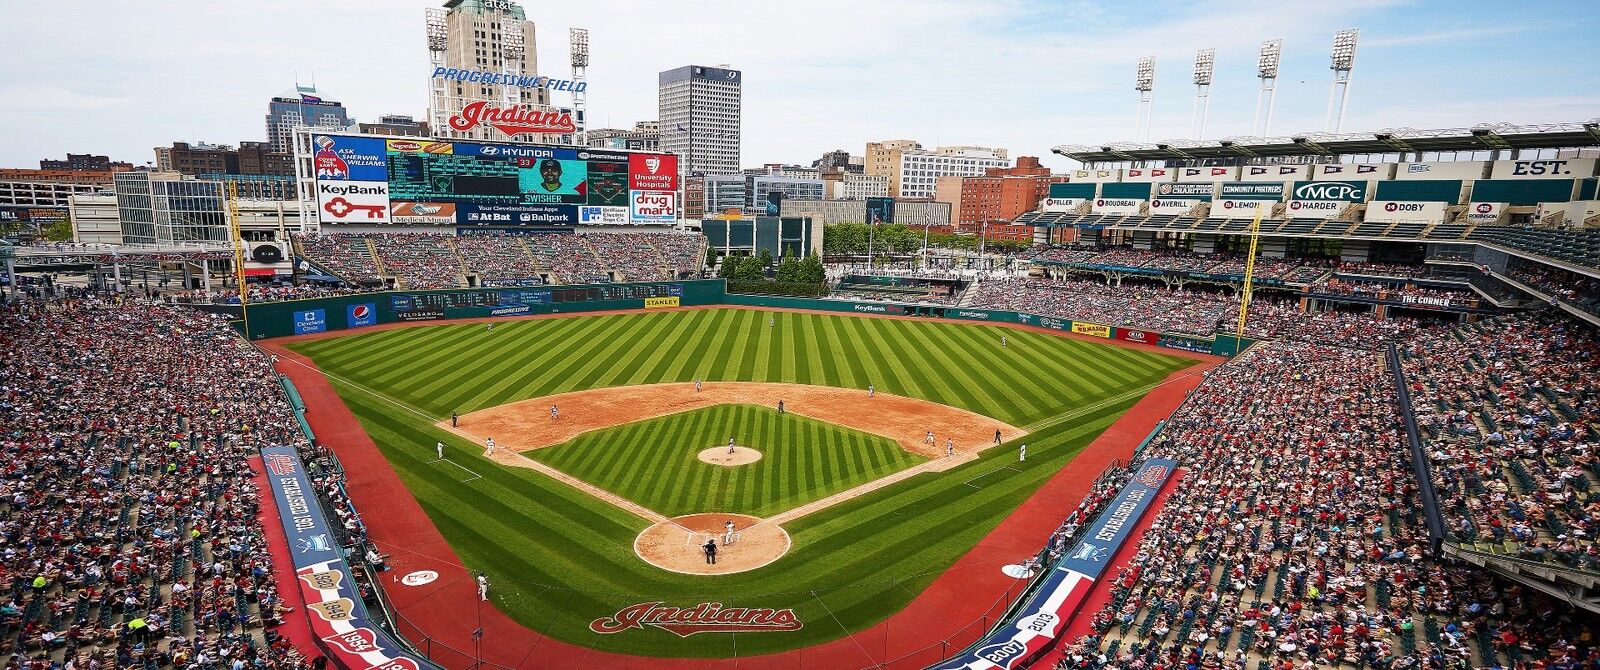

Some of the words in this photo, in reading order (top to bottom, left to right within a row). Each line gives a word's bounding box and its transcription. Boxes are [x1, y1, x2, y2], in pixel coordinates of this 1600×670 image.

[484, 0, 513, 10] at&t
[432, 66, 541, 88] PROGRESSIVE
[545, 78, 587, 93] FIELD
[448, 100, 577, 137] Indians
[341, 154, 379, 162] SHERWIN
[502, 148, 554, 158] HYUNDAI
[347, 159, 386, 167] WILLIAMS
[1512, 160, 1571, 176] EST.
[634, 174, 672, 182] University
[321, 184, 387, 196] KeyBank
[636, 181, 671, 189] Hospitals
[1306, 186, 1361, 199] MCPc
[525, 195, 562, 203] SWISHER
[636, 191, 667, 207] drug
[639, 206, 675, 215] mart
[1302, 202, 1337, 210] HARDER
[532, 214, 568, 222] Ballpark
[1402, 295, 1416, 303] THE
[1418, 296, 1450, 307] CORNER
[491, 306, 529, 315] PROGRESSIVE
[854, 304, 886, 312] KeyBank
[297, 319, 324, 327] Cleveland
[313, 572, 335, 589] 1920
[323, 601, 347, 619] 1948
[588, 601, 804, 638] Indians
[1028, 613, 1054, 632] 2013
[340, 632, 373, 651] 1954
[985, 641, 1020, 662] 2007
